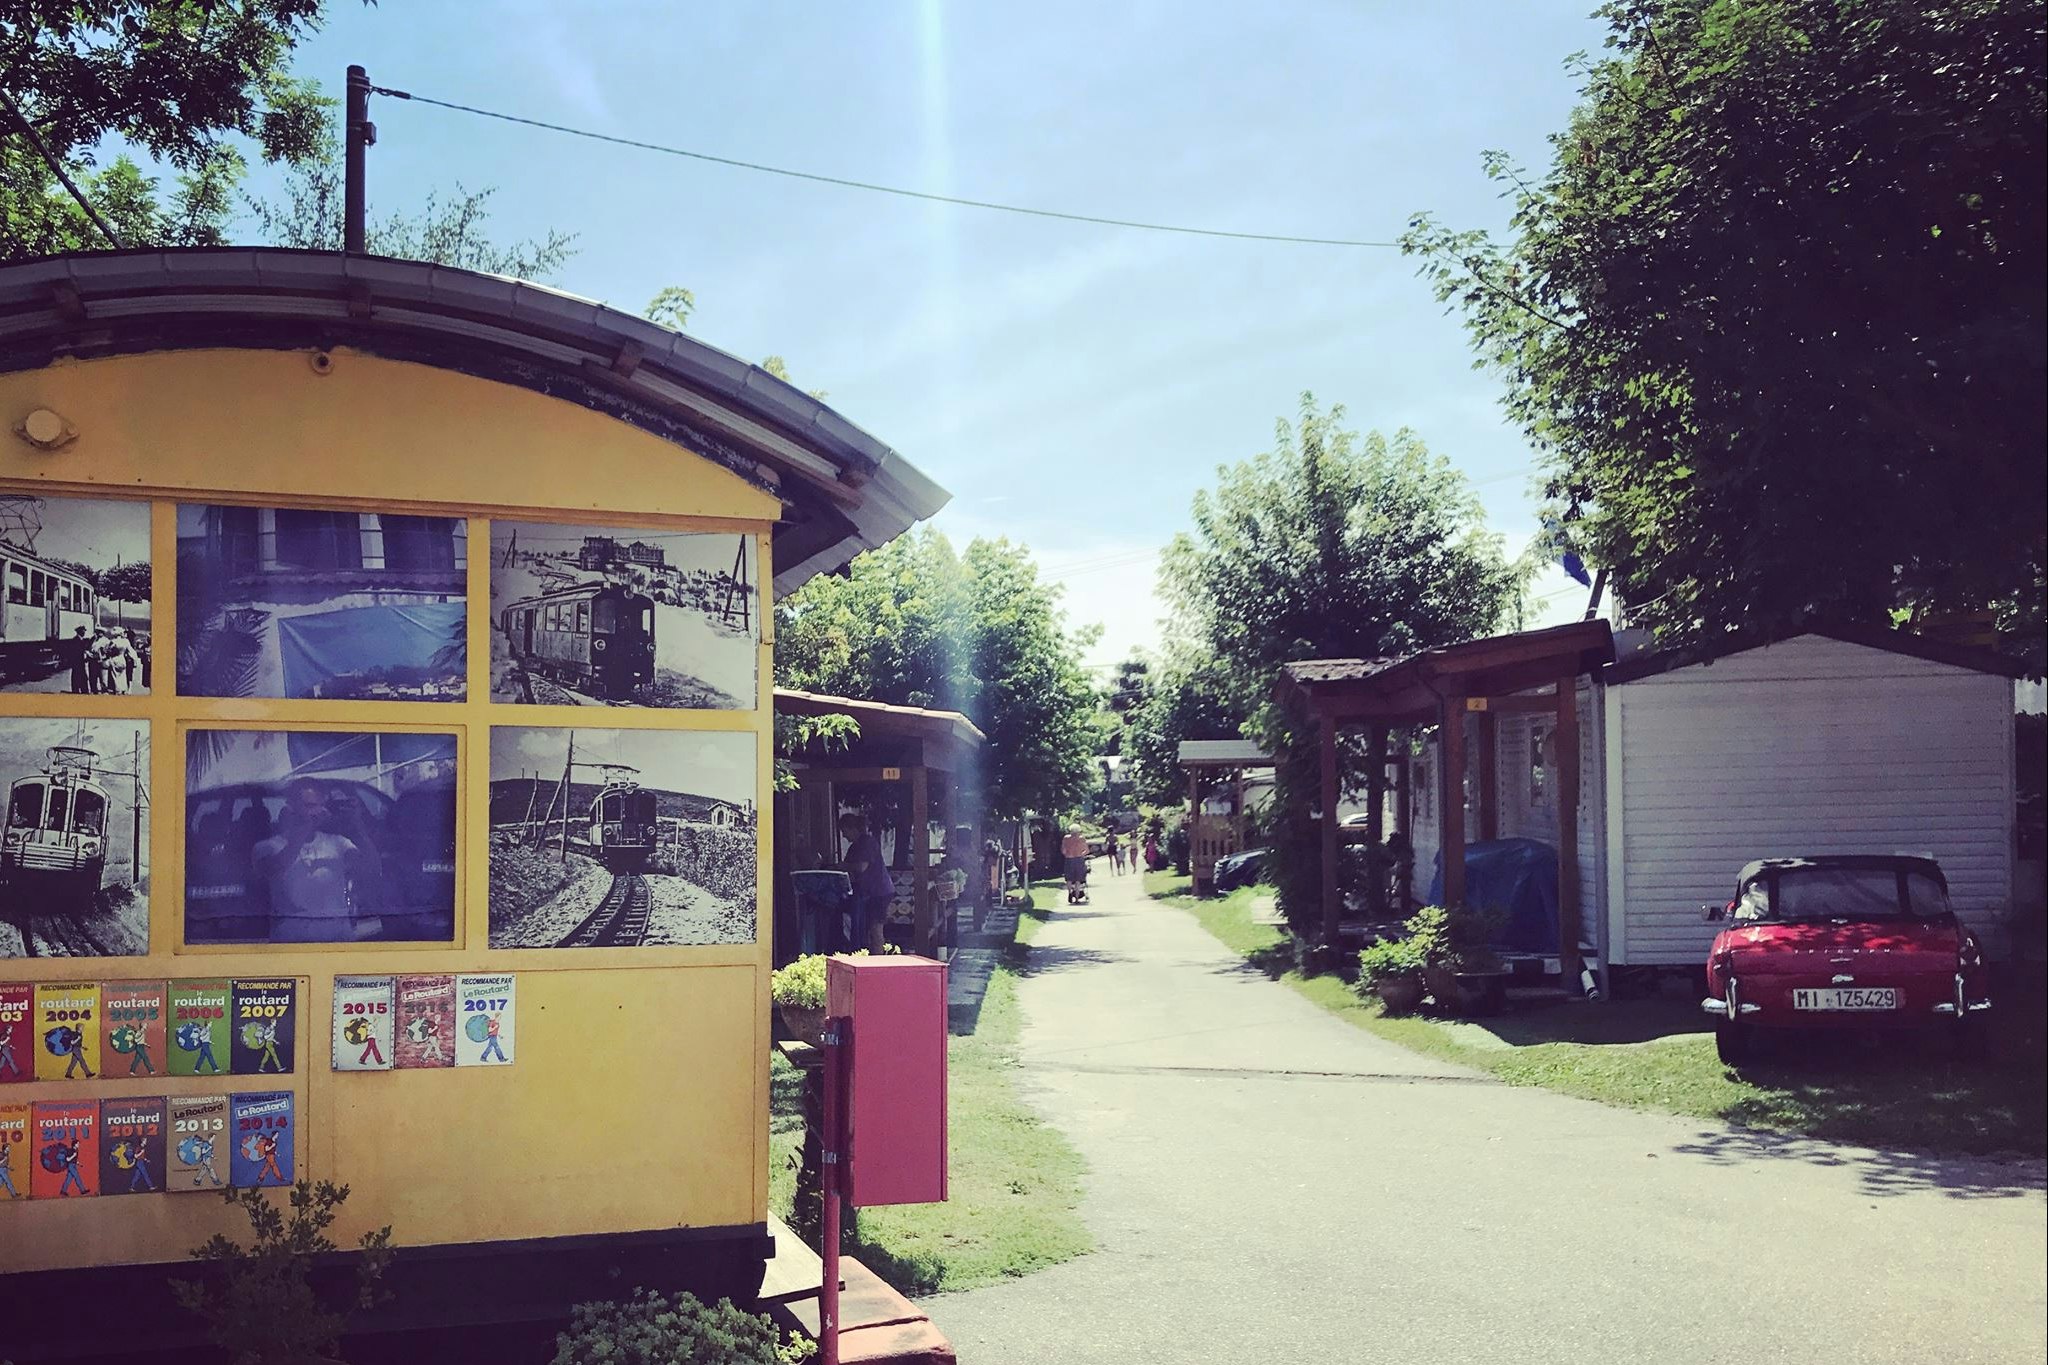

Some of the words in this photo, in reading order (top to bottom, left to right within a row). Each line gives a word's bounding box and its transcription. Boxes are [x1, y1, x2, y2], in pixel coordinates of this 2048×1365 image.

[474, 984, 509, 996] Routard
[40, 997, 94, 1008] routard
[107, 997, 160, 1008] routard
[174, 995, 225, 1007] routard
[238, 995, 290, 1005] routard
[463, 999, 508, 1012] 2017
[110, 1007, 159, 1021] 2005
[177, 1006, 224, 1020] 2006
[240, 1005, 288, 1018] 2007
[343, 1002, 387, 1014] 2015
[45, 1009, 91, 1022] 2004
[185, 1103, 224, 1116] Routard
[249, 1101, 287, 1115] Routard
[40, 1115, 93, 1127] routard
[107, 1112, 160, 1125] routard
[175, 1118, 224, 1132] 2013
[239, 1116, 288, 1131] 2014
[42, 1126, 90, 1141] 2011
[110, 1123, 159, 1137] 2012
